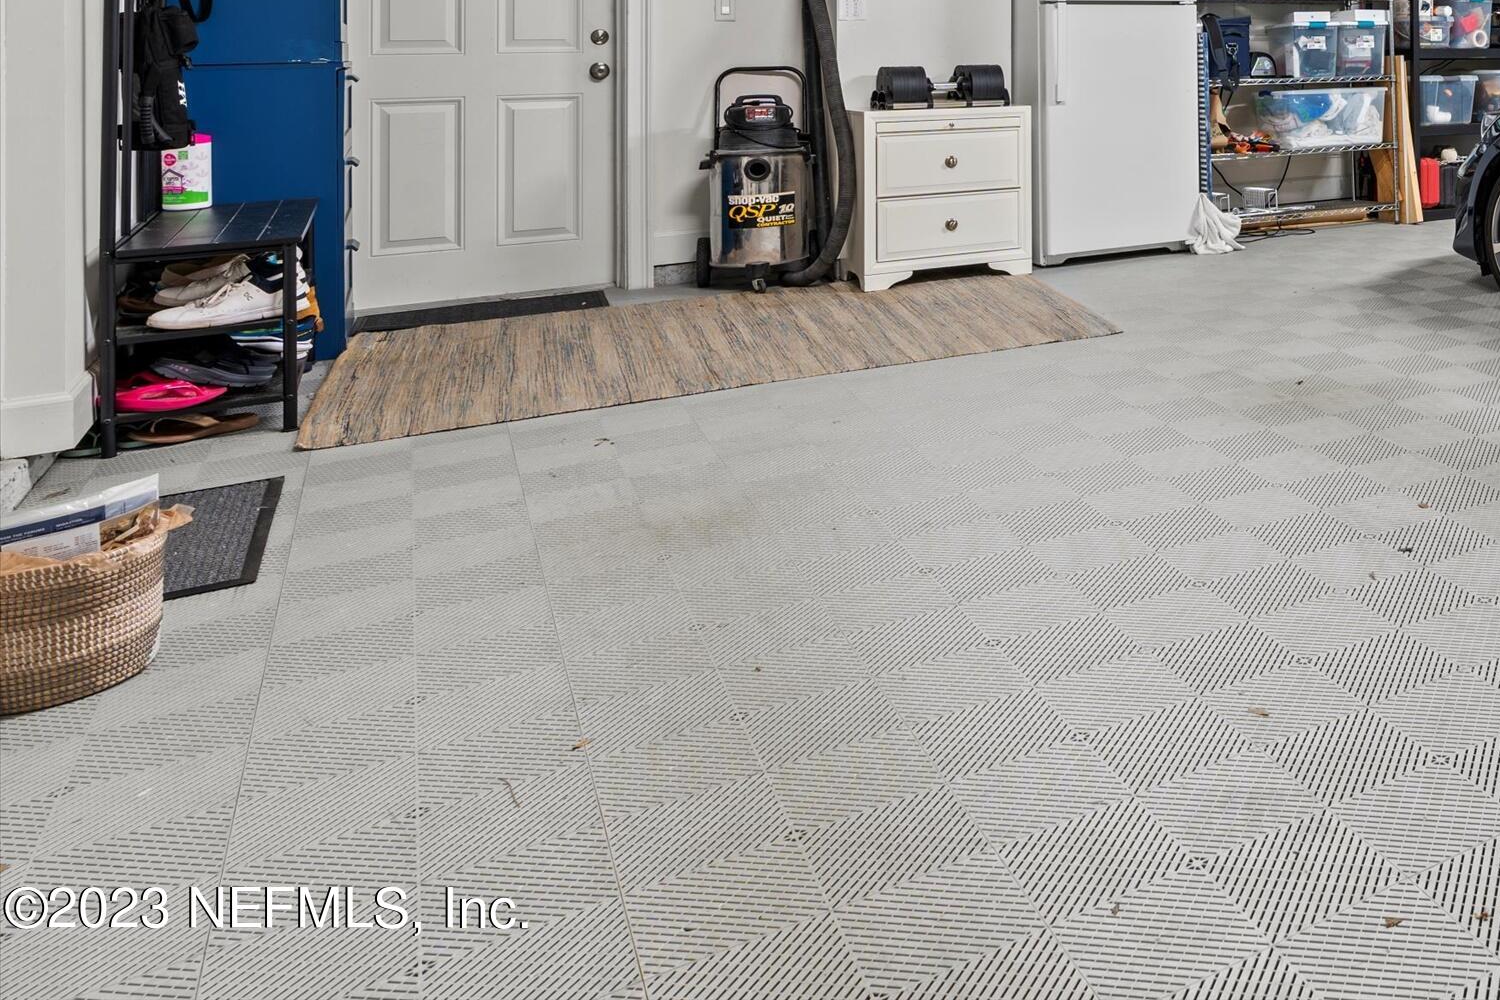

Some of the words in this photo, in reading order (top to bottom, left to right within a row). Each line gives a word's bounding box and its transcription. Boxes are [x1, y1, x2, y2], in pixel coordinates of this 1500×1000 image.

[729, 203, 777, 223] QSP
[778, 203, 795, 214] 10
[757, 214, 786, 224] QUIET
